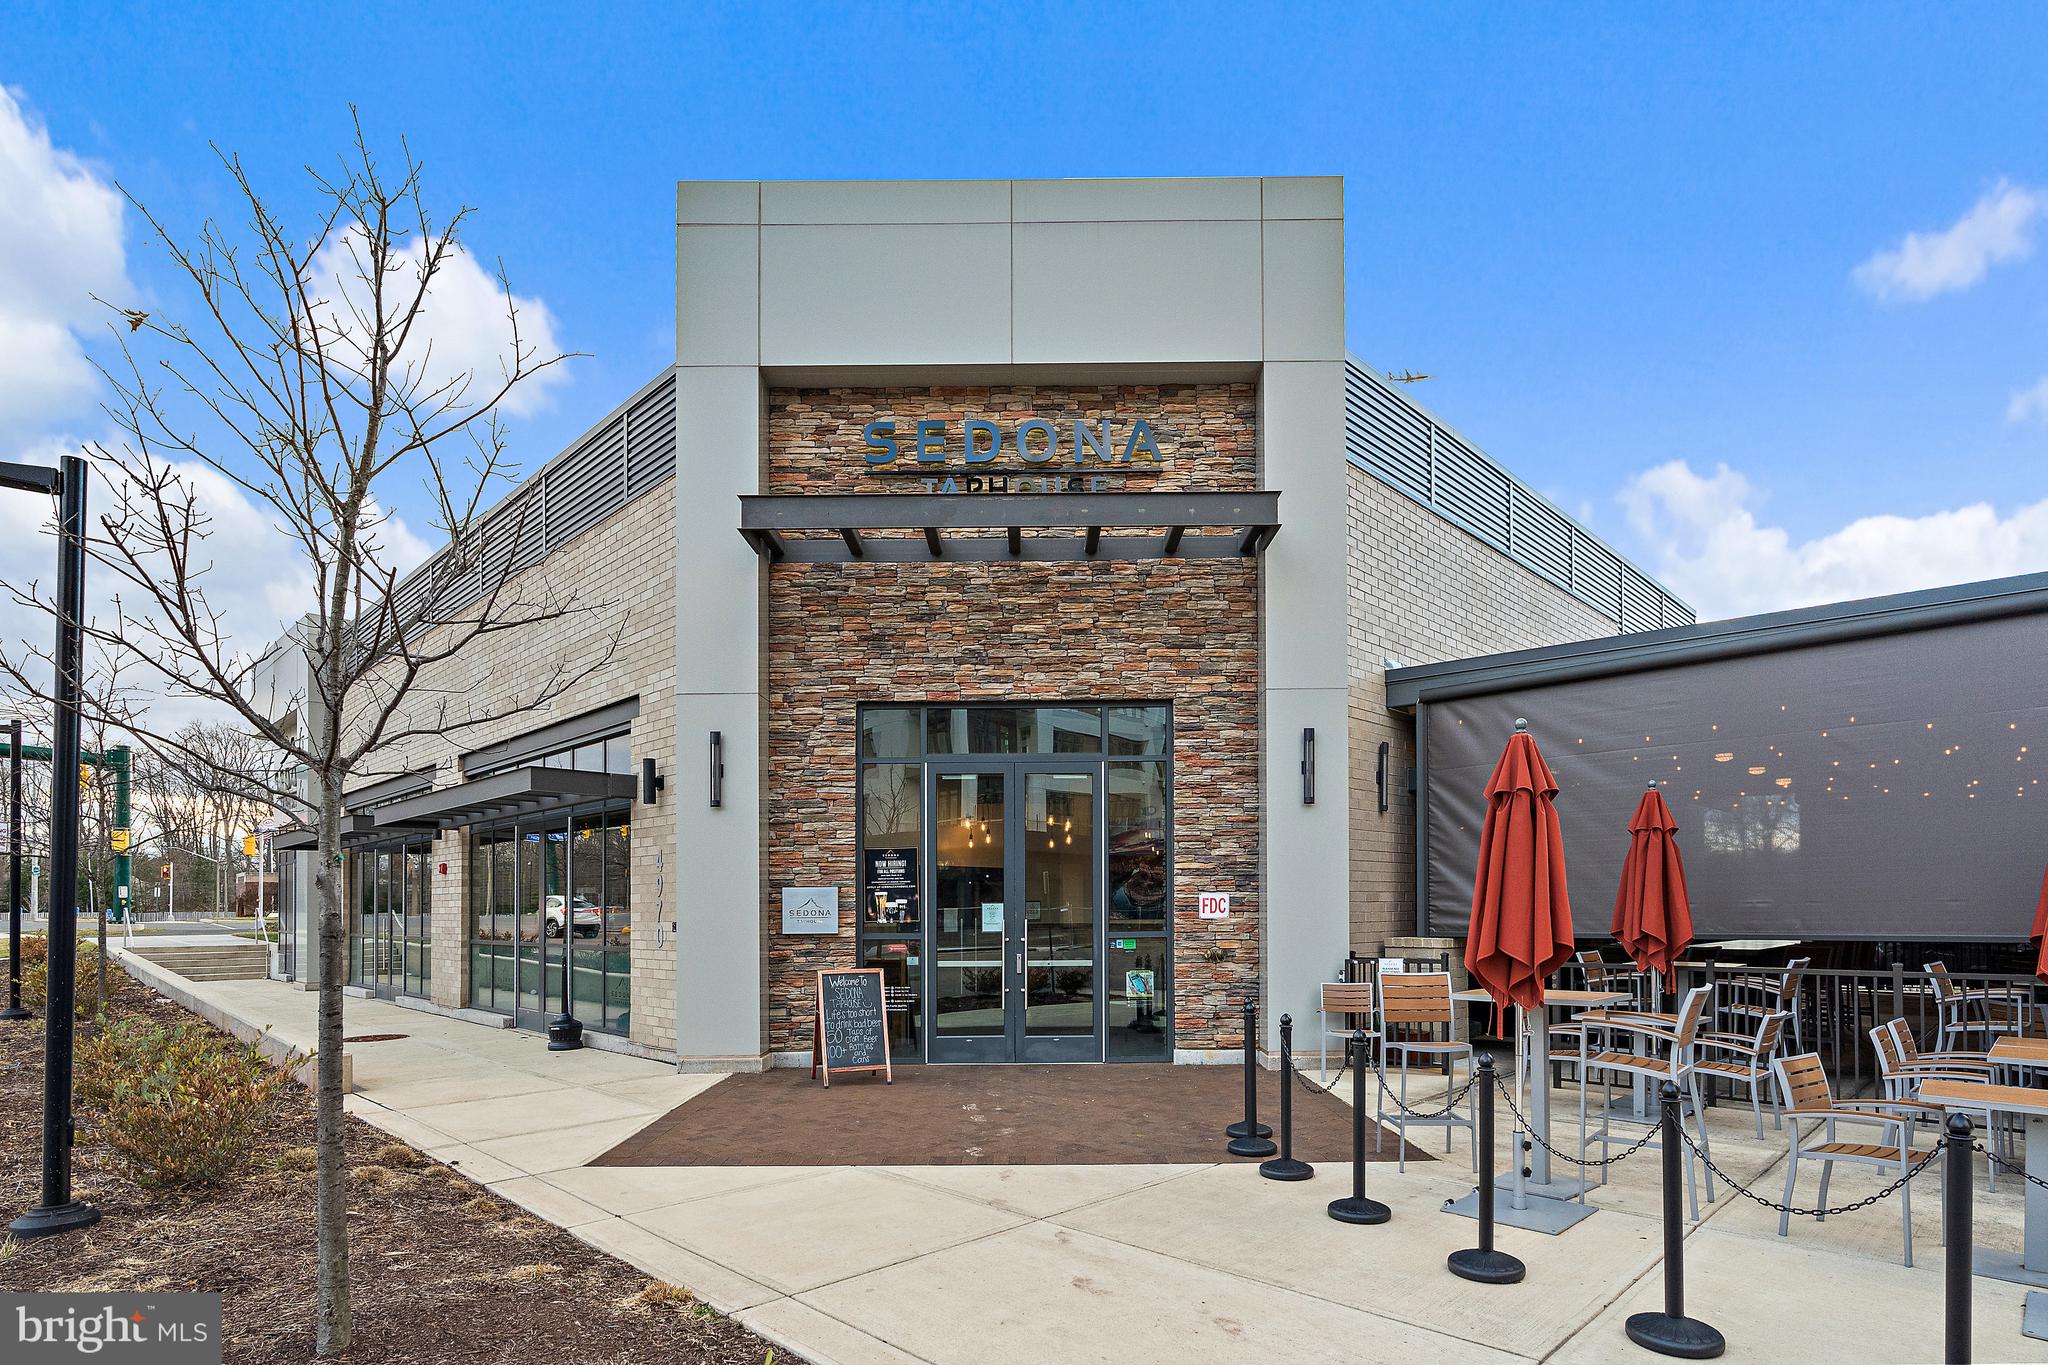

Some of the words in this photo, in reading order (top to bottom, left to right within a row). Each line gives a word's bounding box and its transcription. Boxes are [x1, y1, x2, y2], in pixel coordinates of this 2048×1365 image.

[863, 418, 1163, 464] SEDONA
[920, 476, 1107, 494] TAPHOUSE
[1201, 897, 1227, 914] FDC
[828, 975, 859, 988] Welcome
[834, 987, 864, 1000] SEDONA
[846, 1008, 858, 1019] too
[858, 1006, 877, 1017] short
[835, 1018, 853, 1030] drink
[853, 1018, 867, 1028] bad
[867, 1018, 882, 1028] beer
[826, 1029, 843, 1044] 50
[846, 1028, 864, 1036] Taps
[865, 1027, 873, 1036] of
[863, 1034, 878, 1043] Beer
[849, 1042, 874, 1051] Bottles
[853, 1049, 867, 1057] and
